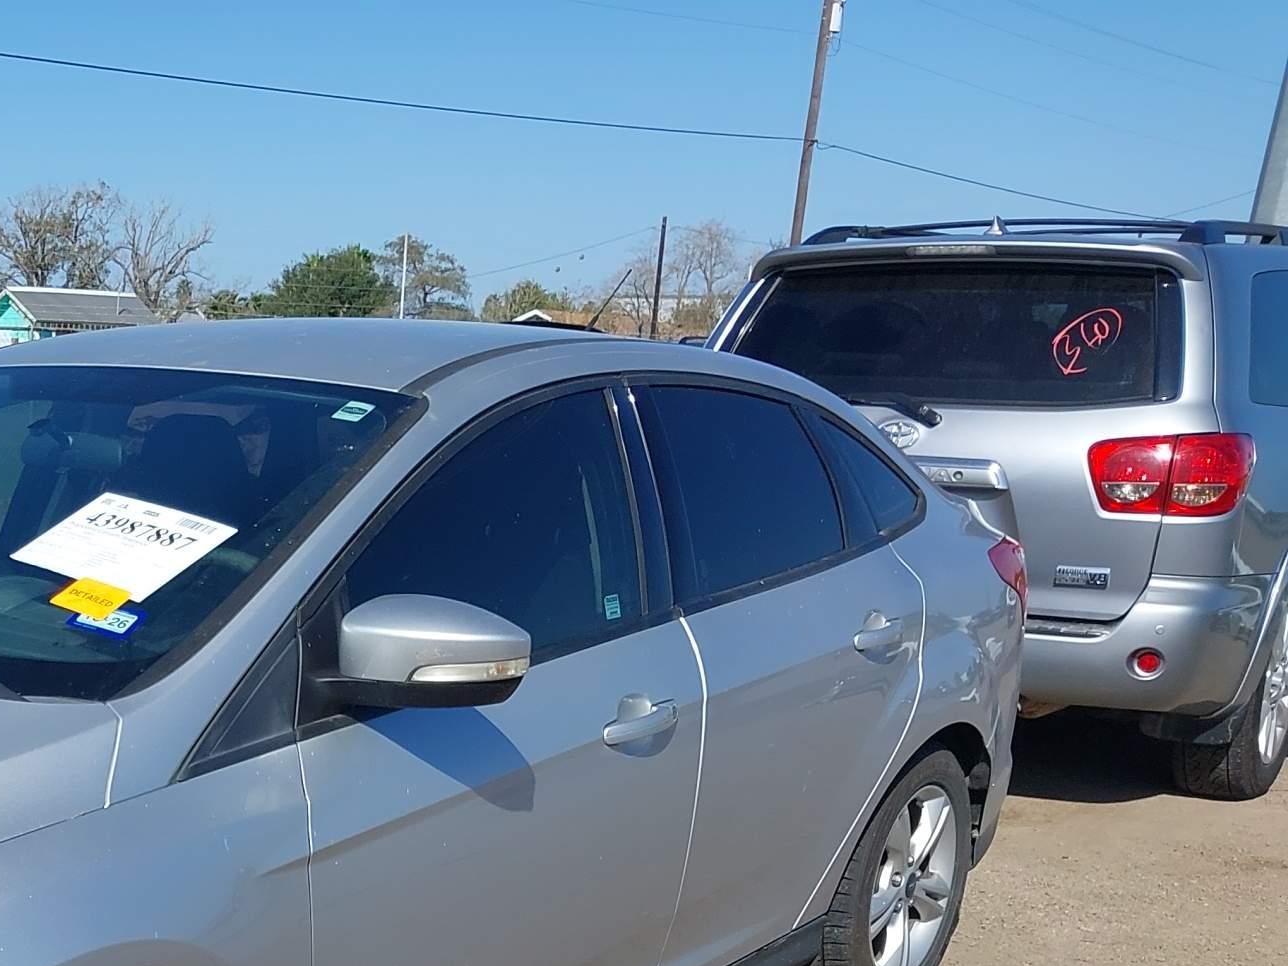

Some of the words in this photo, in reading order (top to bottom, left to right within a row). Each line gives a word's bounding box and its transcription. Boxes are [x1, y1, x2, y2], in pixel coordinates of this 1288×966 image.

[86, 511, 198, 551] 43987887
[70, 588, 114, 608] DETAILED
[107, 617, 129, 629] 26
